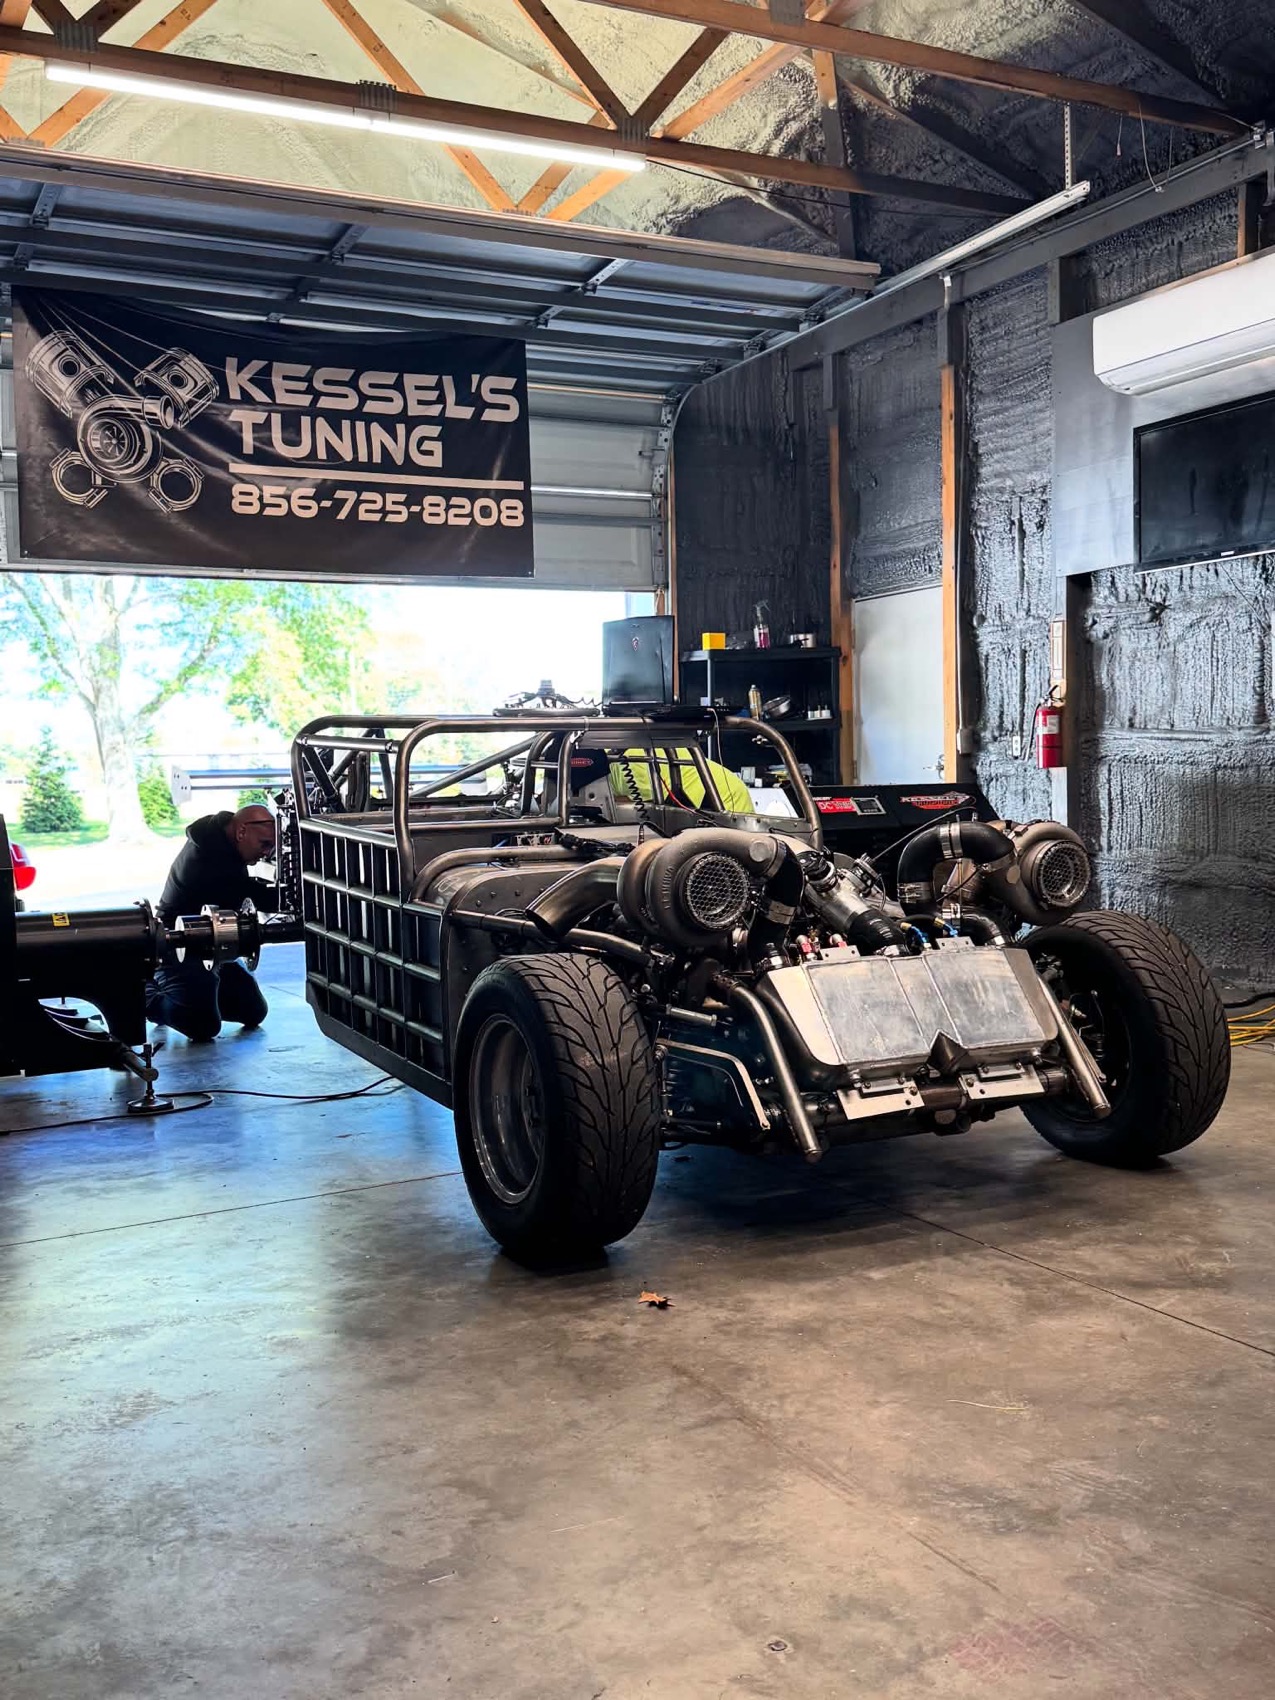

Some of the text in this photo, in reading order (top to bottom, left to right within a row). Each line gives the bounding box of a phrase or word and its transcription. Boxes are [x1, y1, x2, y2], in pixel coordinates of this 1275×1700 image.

[225, 357, 520, 422] KESSEL'S
[228, 410, 443, 468] TUNING
[231, 482, 525, 527] 856-725-8208
